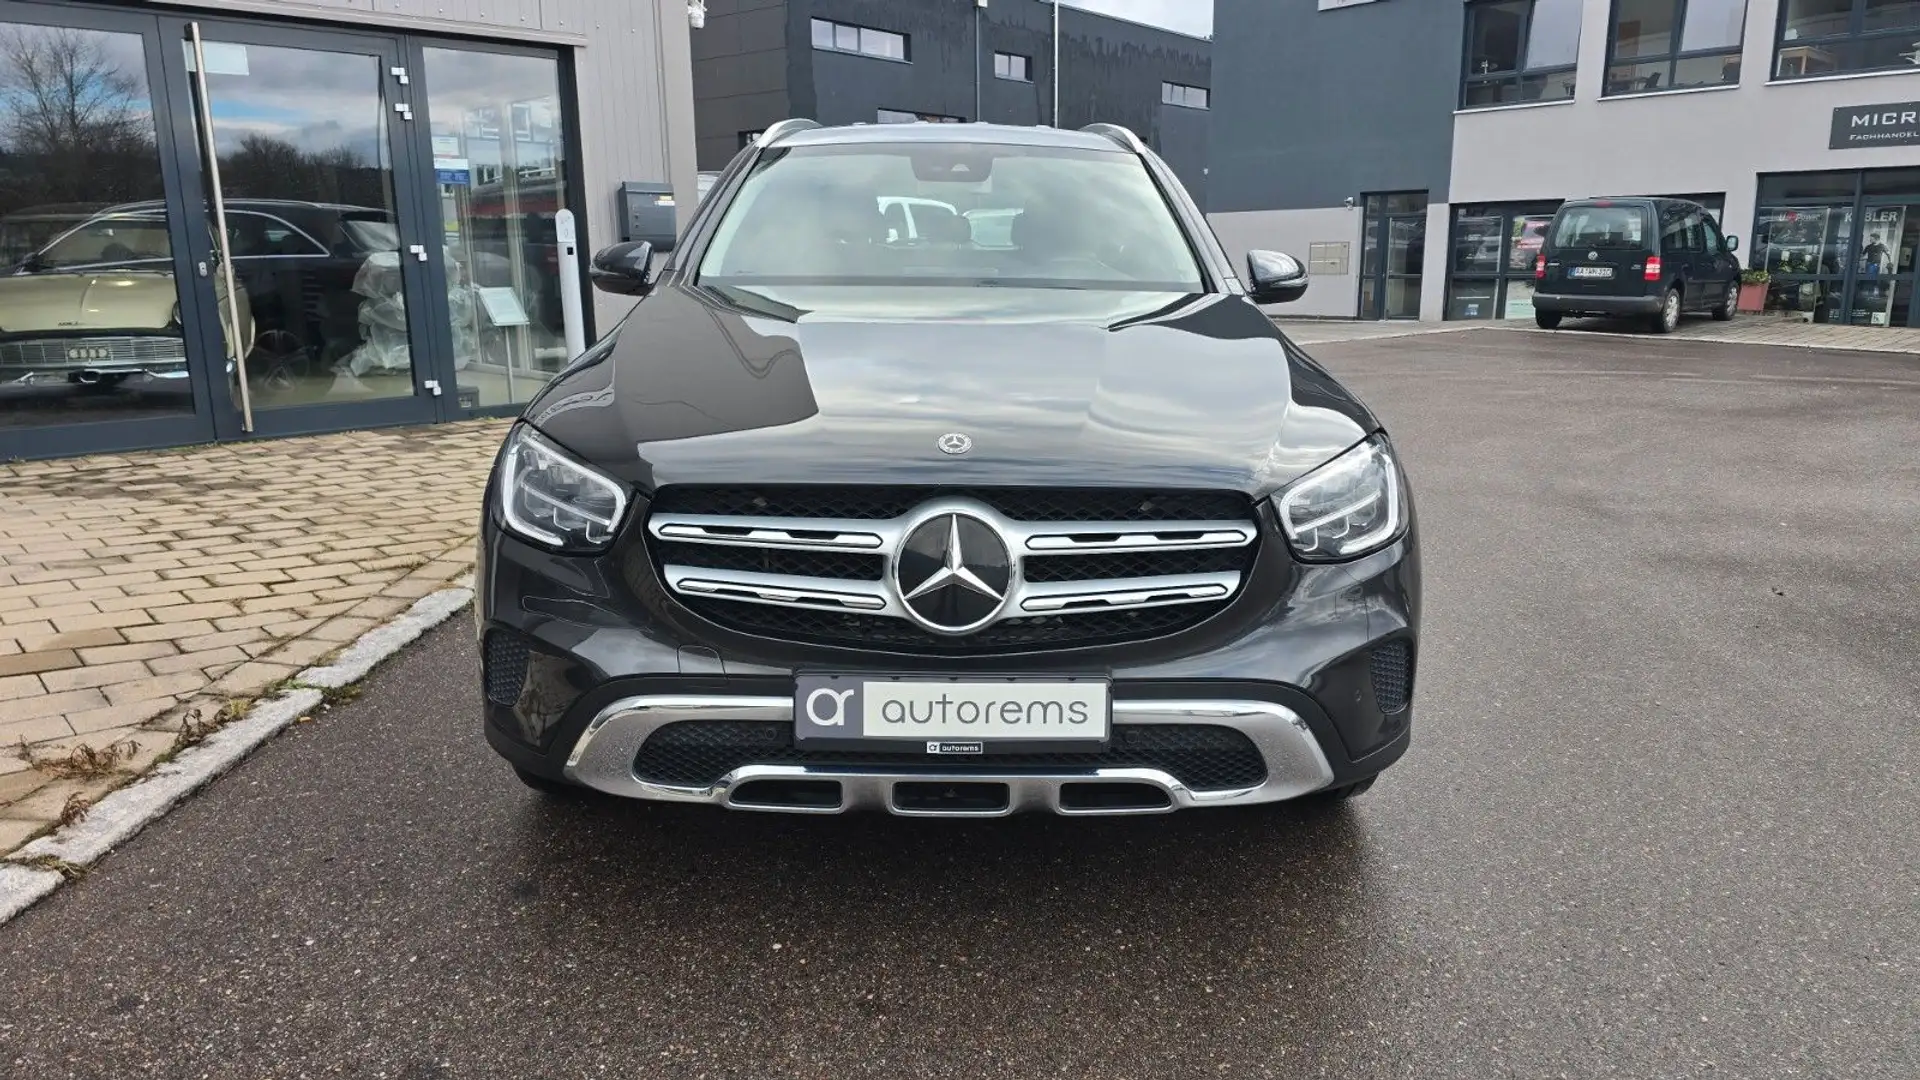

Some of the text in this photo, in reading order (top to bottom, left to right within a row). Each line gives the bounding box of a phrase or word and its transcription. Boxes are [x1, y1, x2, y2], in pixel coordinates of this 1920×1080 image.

[1851, 111, 1920, 127] MICR
[1849, 131, 1920, 141] FACHHANDEL
[1844, 211, 1899, 223] KBLER
[881, 693, 1089, 725] autorems
[941, 744, 980, 752] autorems
